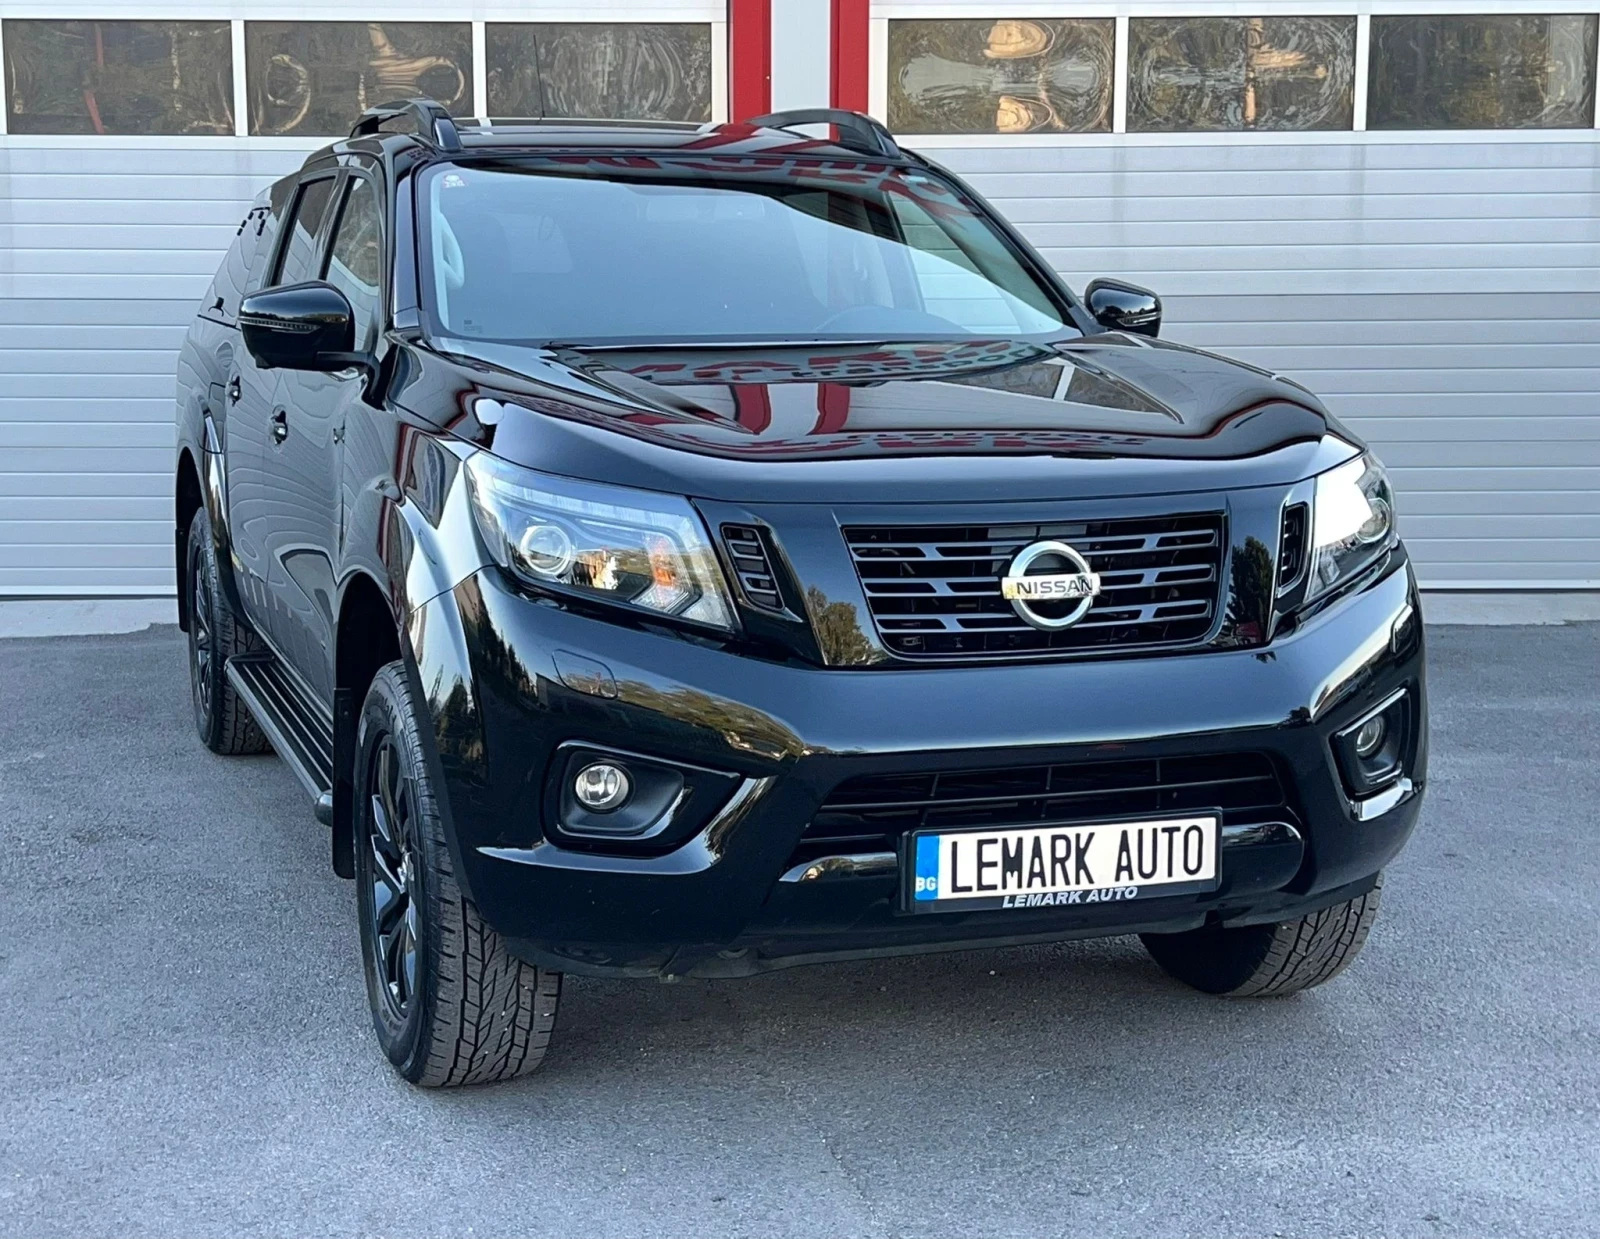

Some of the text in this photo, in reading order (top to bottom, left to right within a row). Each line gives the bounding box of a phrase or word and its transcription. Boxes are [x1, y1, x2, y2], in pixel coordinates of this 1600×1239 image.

[1016, 578, 1093, 595] NISSAN
[950, 824, 1204, 893] LEMARK AUTO
[915, 876, 937, 891] BG
[1002, 886, 1138, 909] LEMARK AUTO
